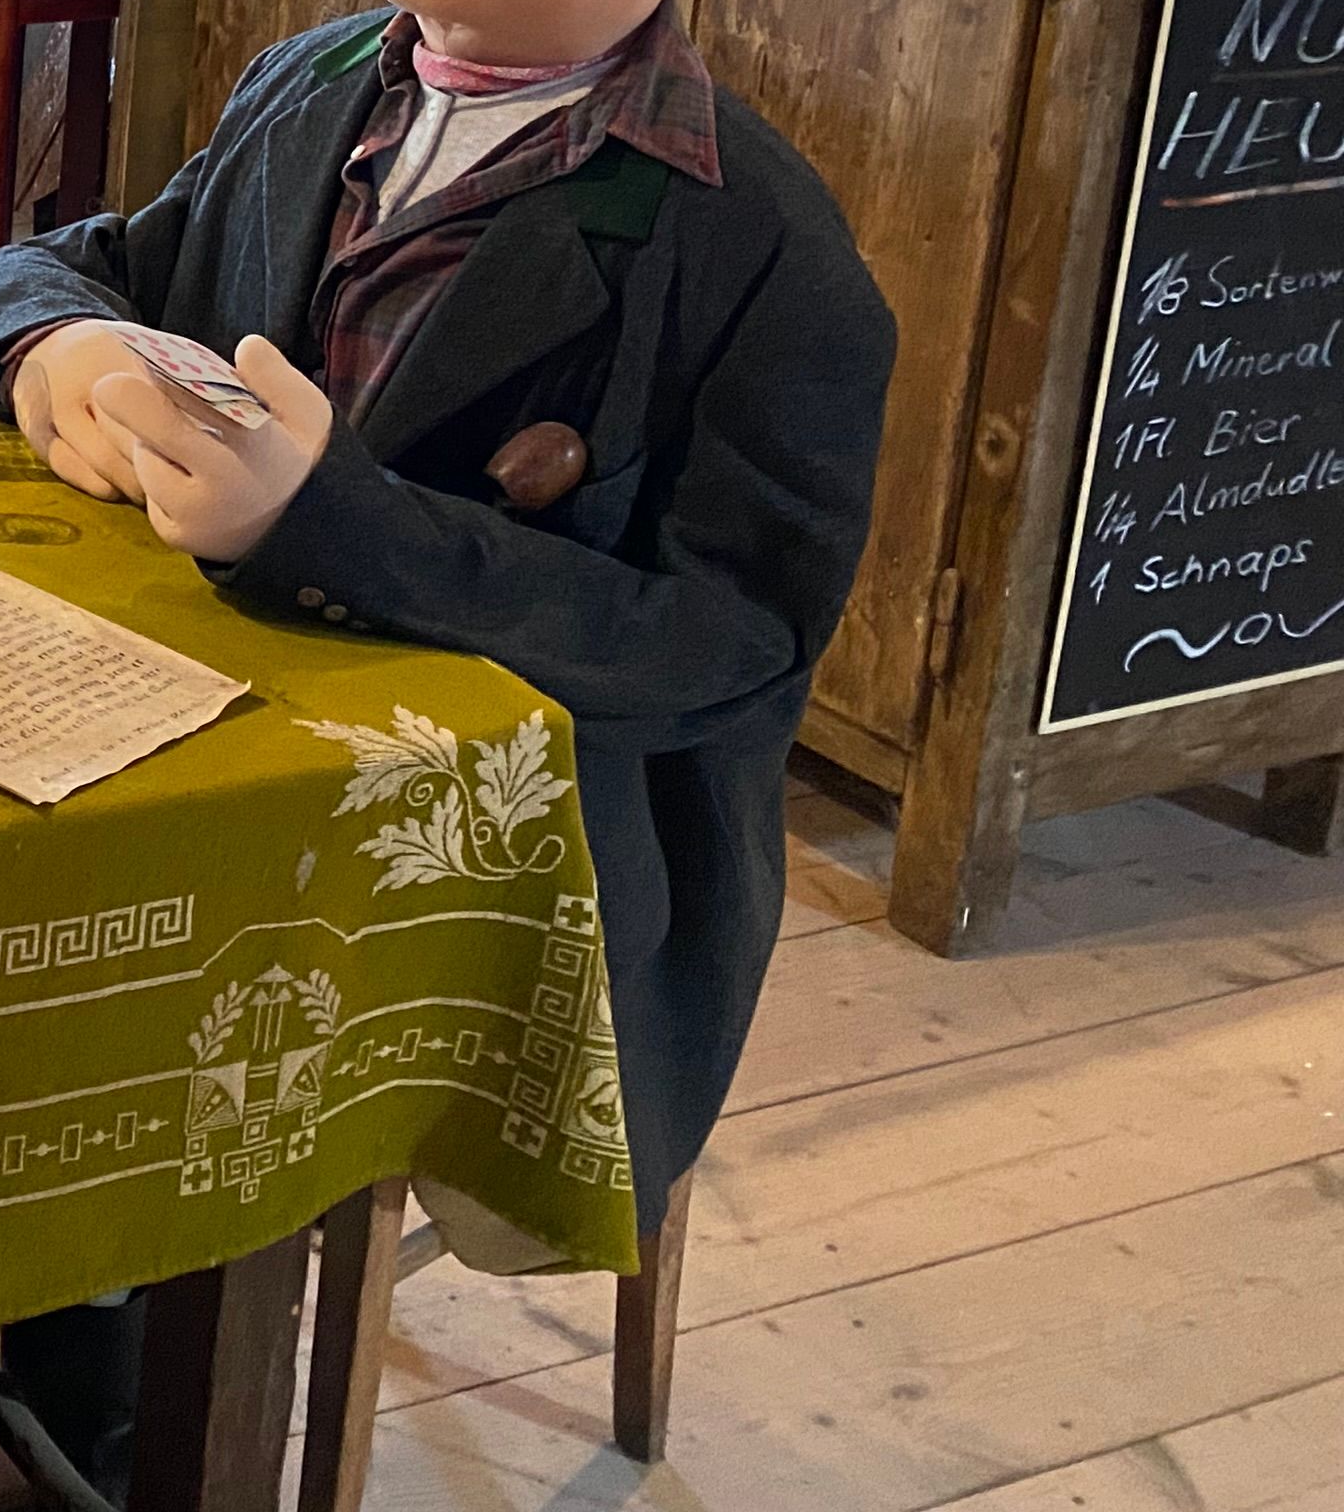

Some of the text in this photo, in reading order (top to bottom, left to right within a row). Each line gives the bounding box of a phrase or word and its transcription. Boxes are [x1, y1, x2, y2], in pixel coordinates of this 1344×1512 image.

[1125, 320, 1341, 398] 1/4 Mineral
[1204, 410, 1302, 457] Bier
[1135, 540, 1313, 592] Schnaps
